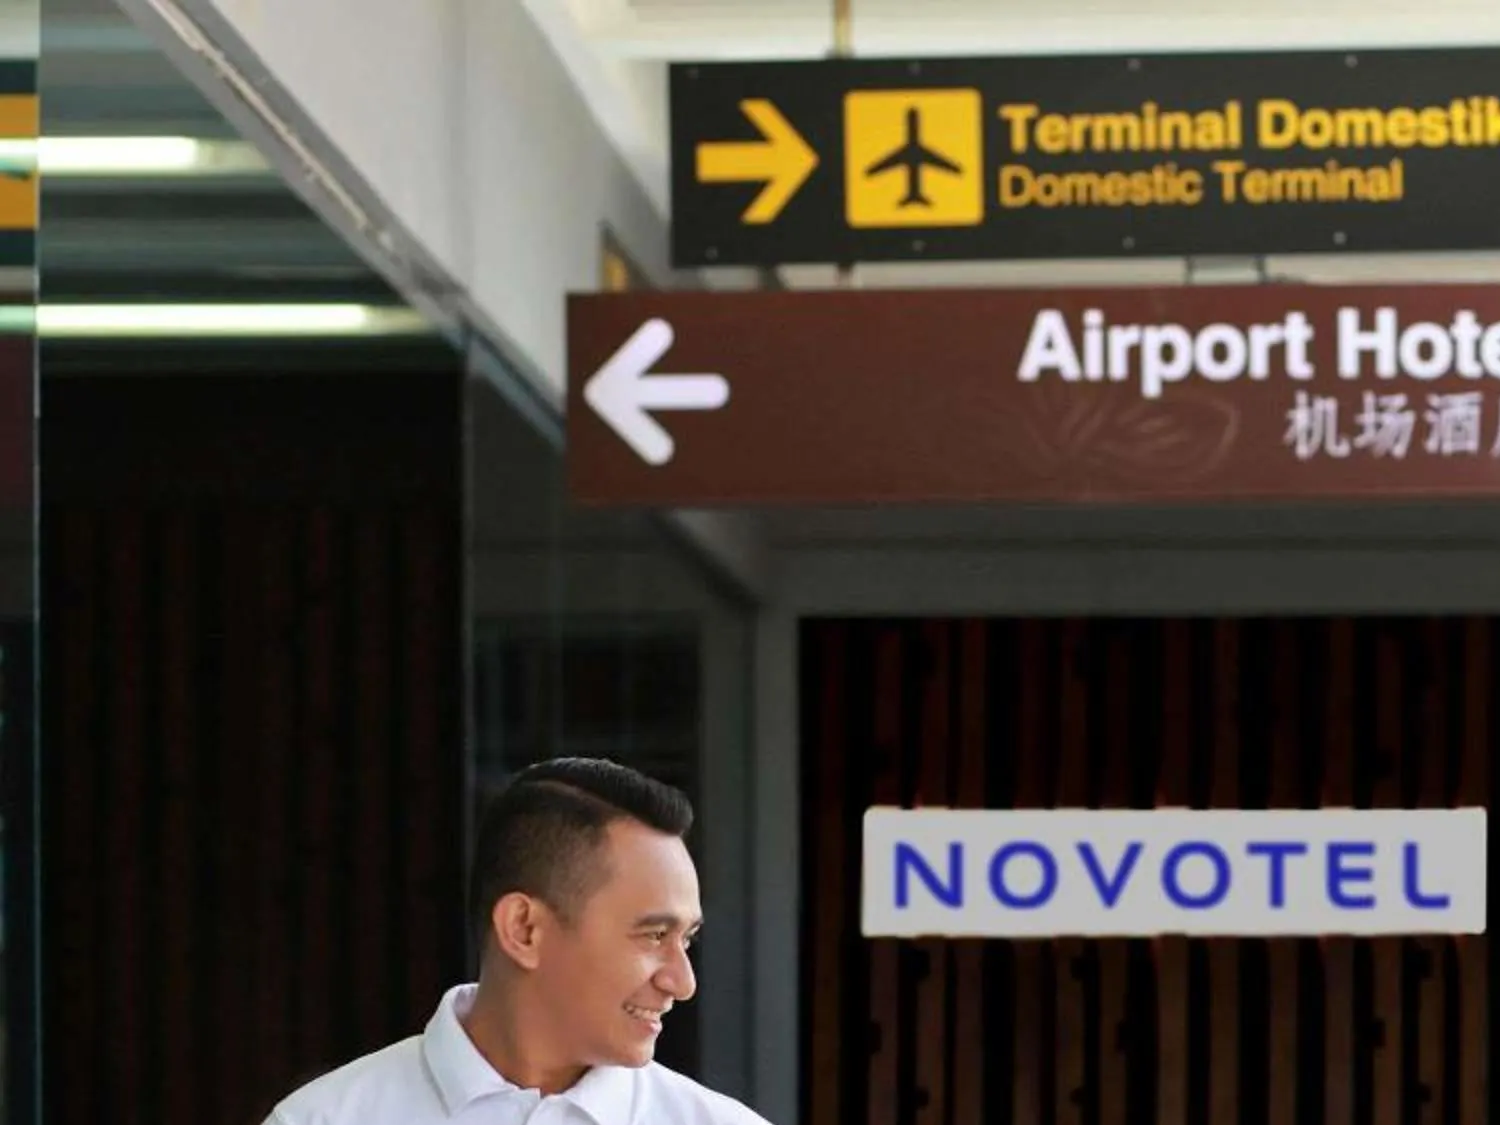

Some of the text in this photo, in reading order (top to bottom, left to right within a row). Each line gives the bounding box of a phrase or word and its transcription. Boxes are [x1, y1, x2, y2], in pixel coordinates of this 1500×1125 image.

[1000, 101, 1242, 154] Terminal
[999, 160, 1404, 207] Domestic Terminal
[1018, 308, 1313, 399] Airport
[893, 840, 1450, 909] NOVOTEL
